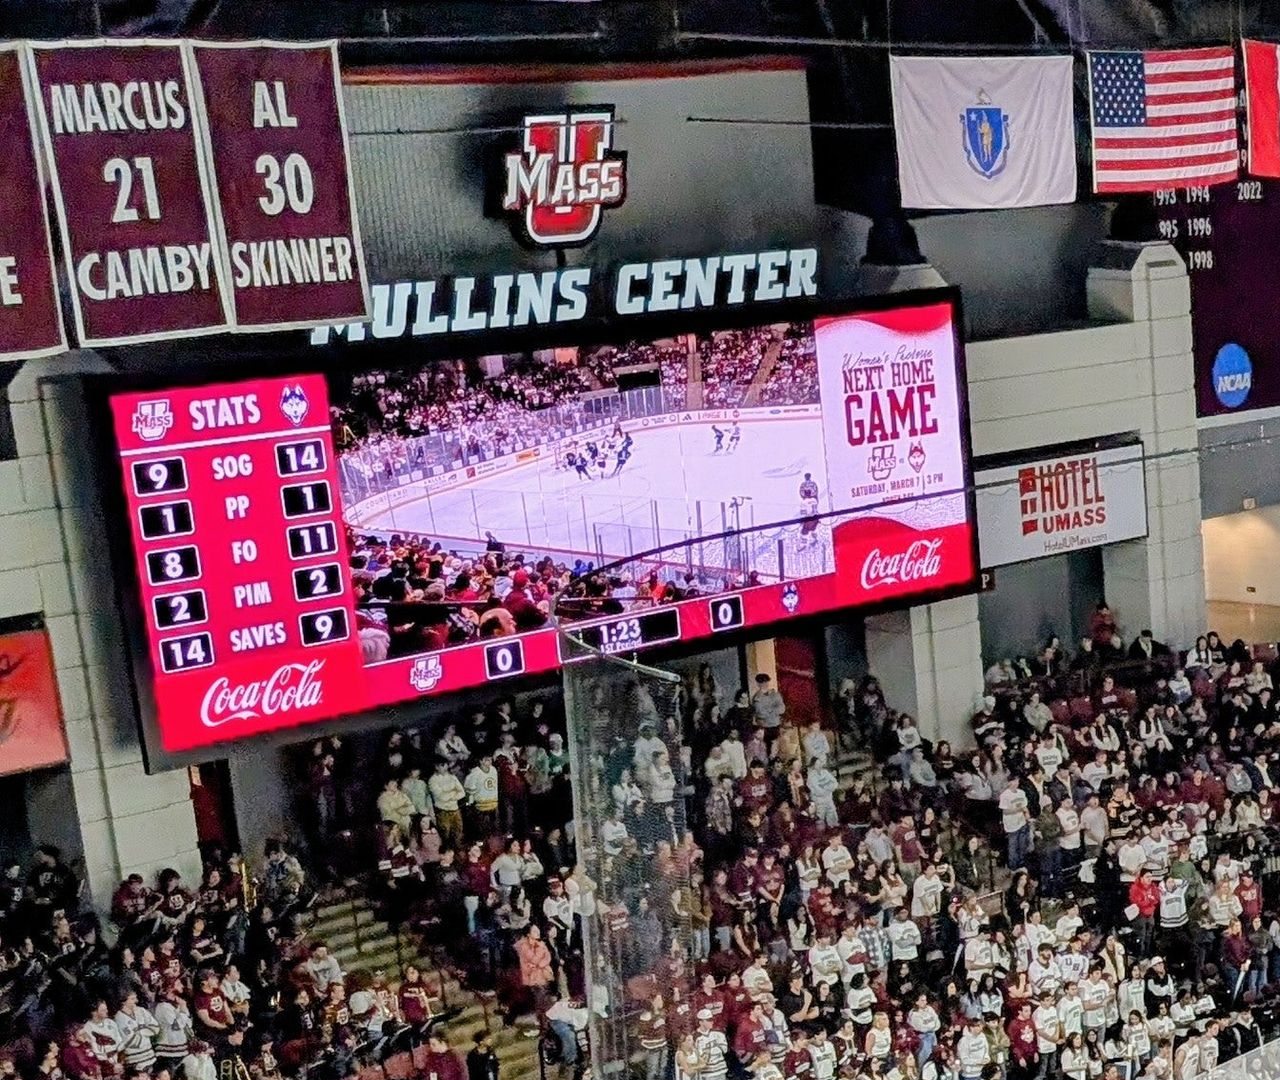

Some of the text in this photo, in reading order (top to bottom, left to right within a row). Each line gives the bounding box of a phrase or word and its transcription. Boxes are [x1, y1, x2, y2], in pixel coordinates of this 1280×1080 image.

[51, 81, 186, 134] MARCUS
[253, 81, 297, 128] AL
[103, 156, 161, 223] 21
[256, 153, 314, 216] 30
[1237, 182, 1262, 200] 2022
[1158, 218, 1212, 238] 995 1996
[77, 243, 212, 301] CAMBY
[233, 237, 354, 288] SKINNER
[616, 248, 818, 316] CENTER
[1189, 251, 1213, 270] 1998
[842, 358, 934, 394] NEXT HOME
[1217, 372, 1252, 392] NCAA
[189, 395, 261, 431] STATS
[845, 383, 939, 447] GAME
[153, 445, 319, 490] 9 SOG 14
[890, 478, 914, 491] MARCH
[1040, 456, 1105, 513] HOTEL
[161, 487, 316, 533] 1 PP 1
[1043, 506, 1106, 535] UMASS
[166, 527, 328, 579] 8 FO 11
[860, 536, 943, 589] Coca-Cola
[172, 570, 327, 623] 2 PIM 2
[718, 606, 733, 626] 0
[172, 614, 332, 668] 14 SAVES 9
[600, 619, 641, 643] 1:23
[496, 650, 512, 672] 0
[200, 658, 327, 728] Coca-Cola
